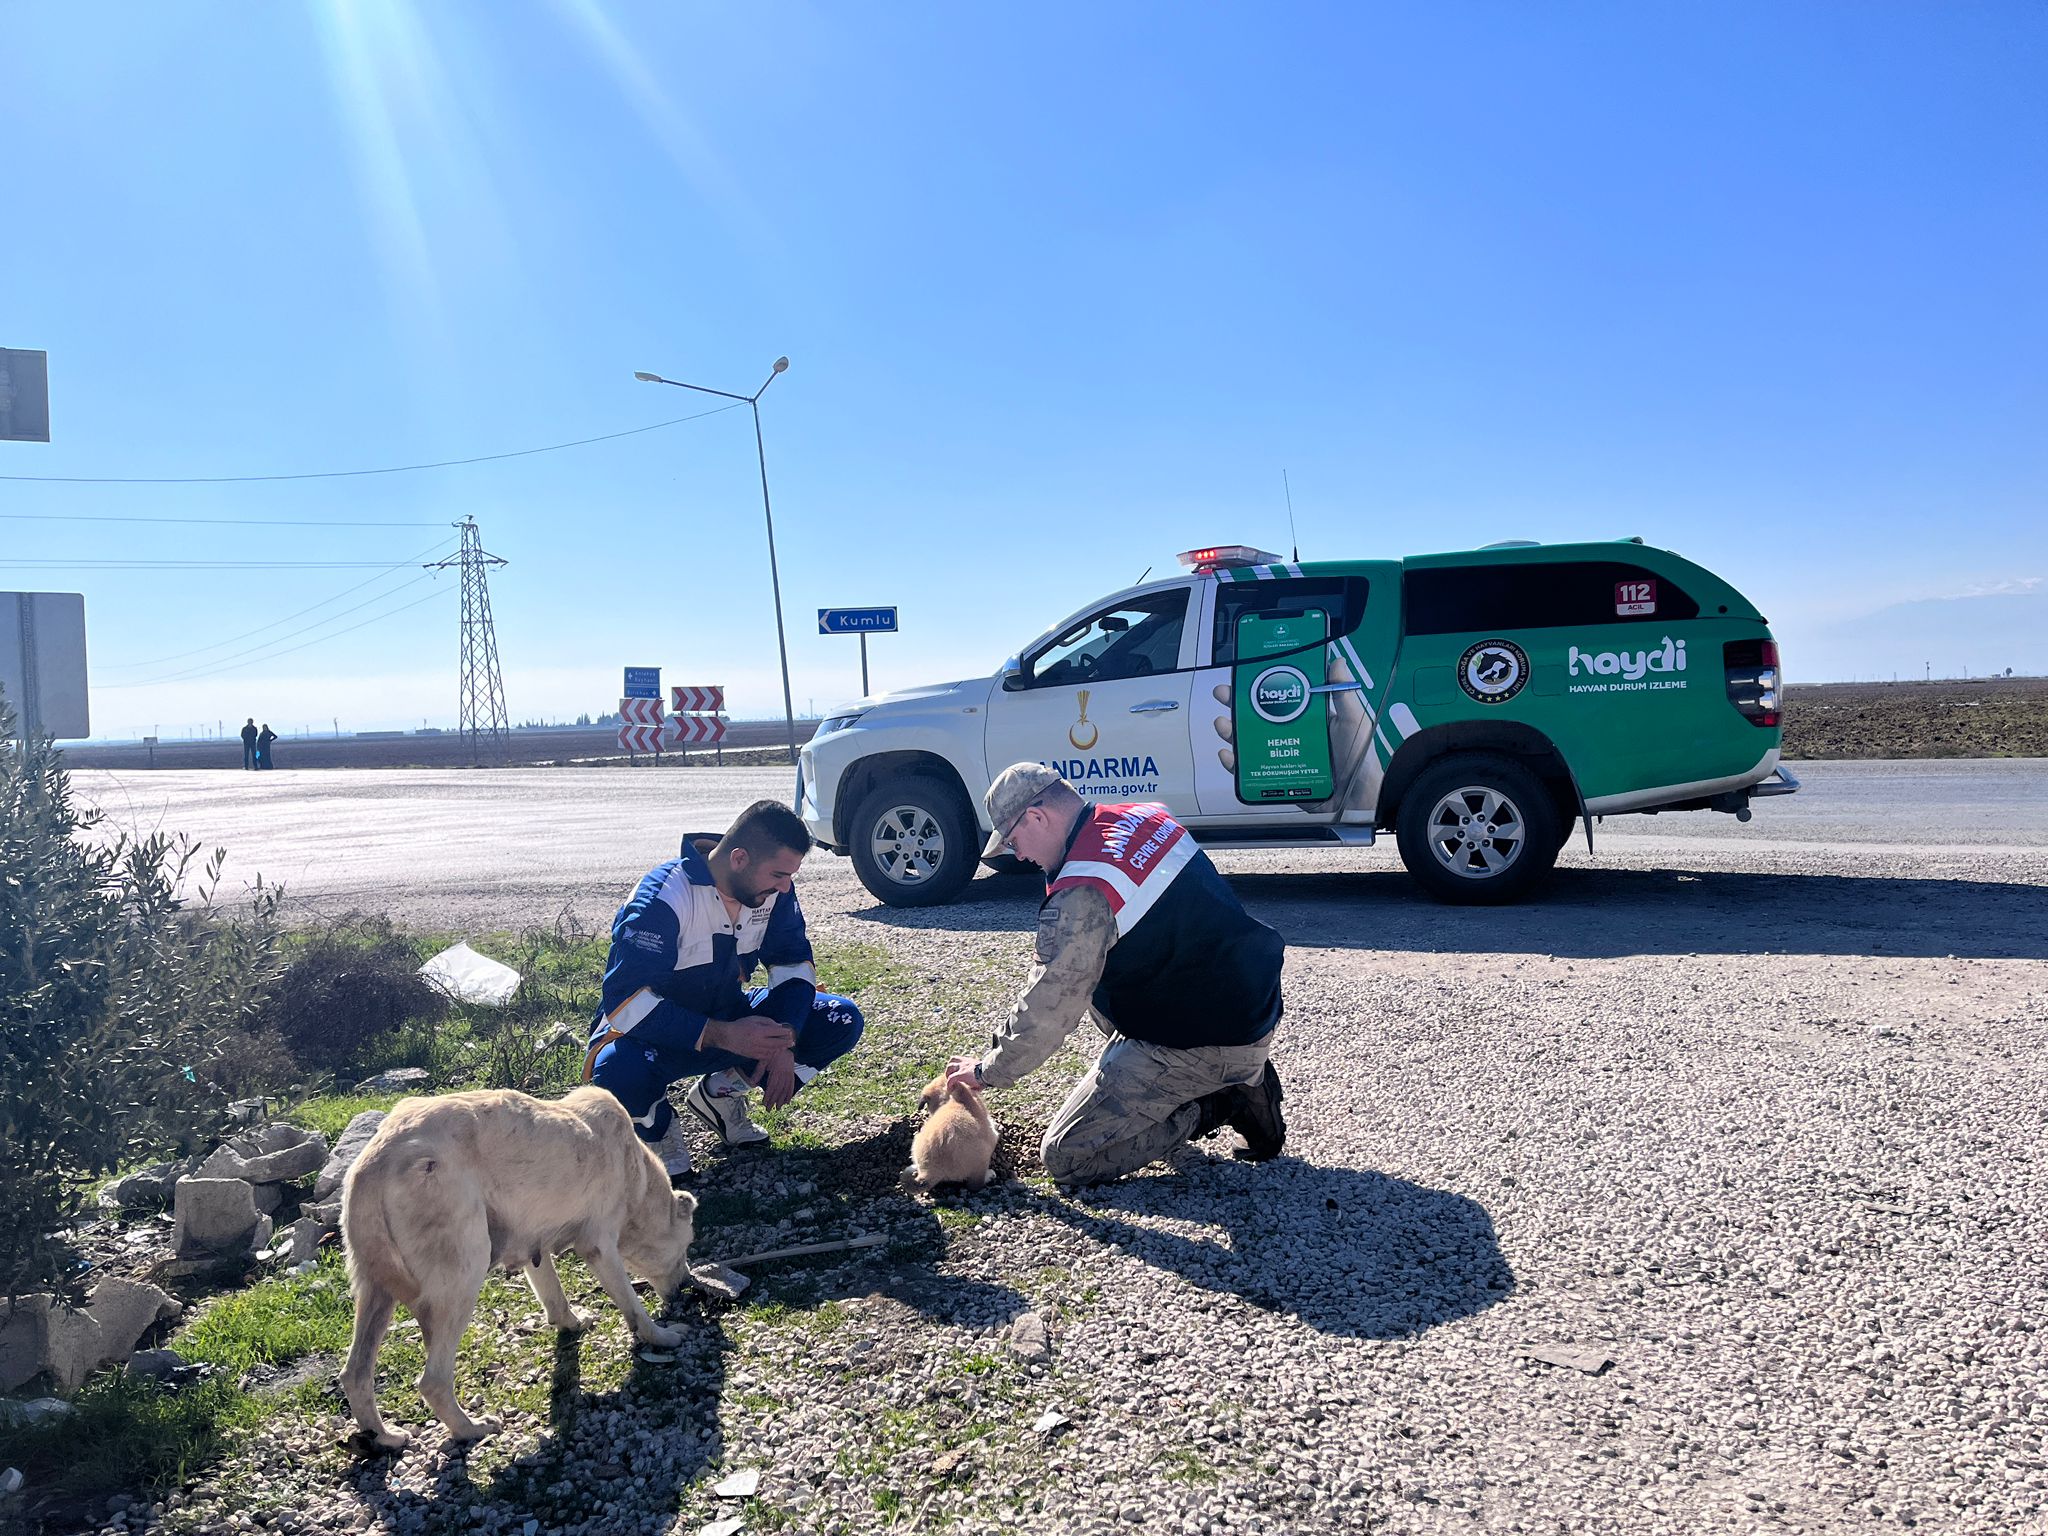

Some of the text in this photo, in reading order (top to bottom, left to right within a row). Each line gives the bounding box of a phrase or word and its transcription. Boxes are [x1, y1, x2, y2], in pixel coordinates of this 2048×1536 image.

[1620, 583, 1651, 602] 112
[839, 614, 892, 626] Kumlu
[1568, 635, 1687, 680] haydi
[1259, 684, 1301, 701] haydi
[1569, 681, 1607, 693] HAYVAN
[1609, 681, 1647, 692] DURUM
[1267, 738, 1300, 747] HEMEN
[1270, 749, 1300, 758] BİLDİR
[1129, 839, 1160, 871] ÇEVRE
